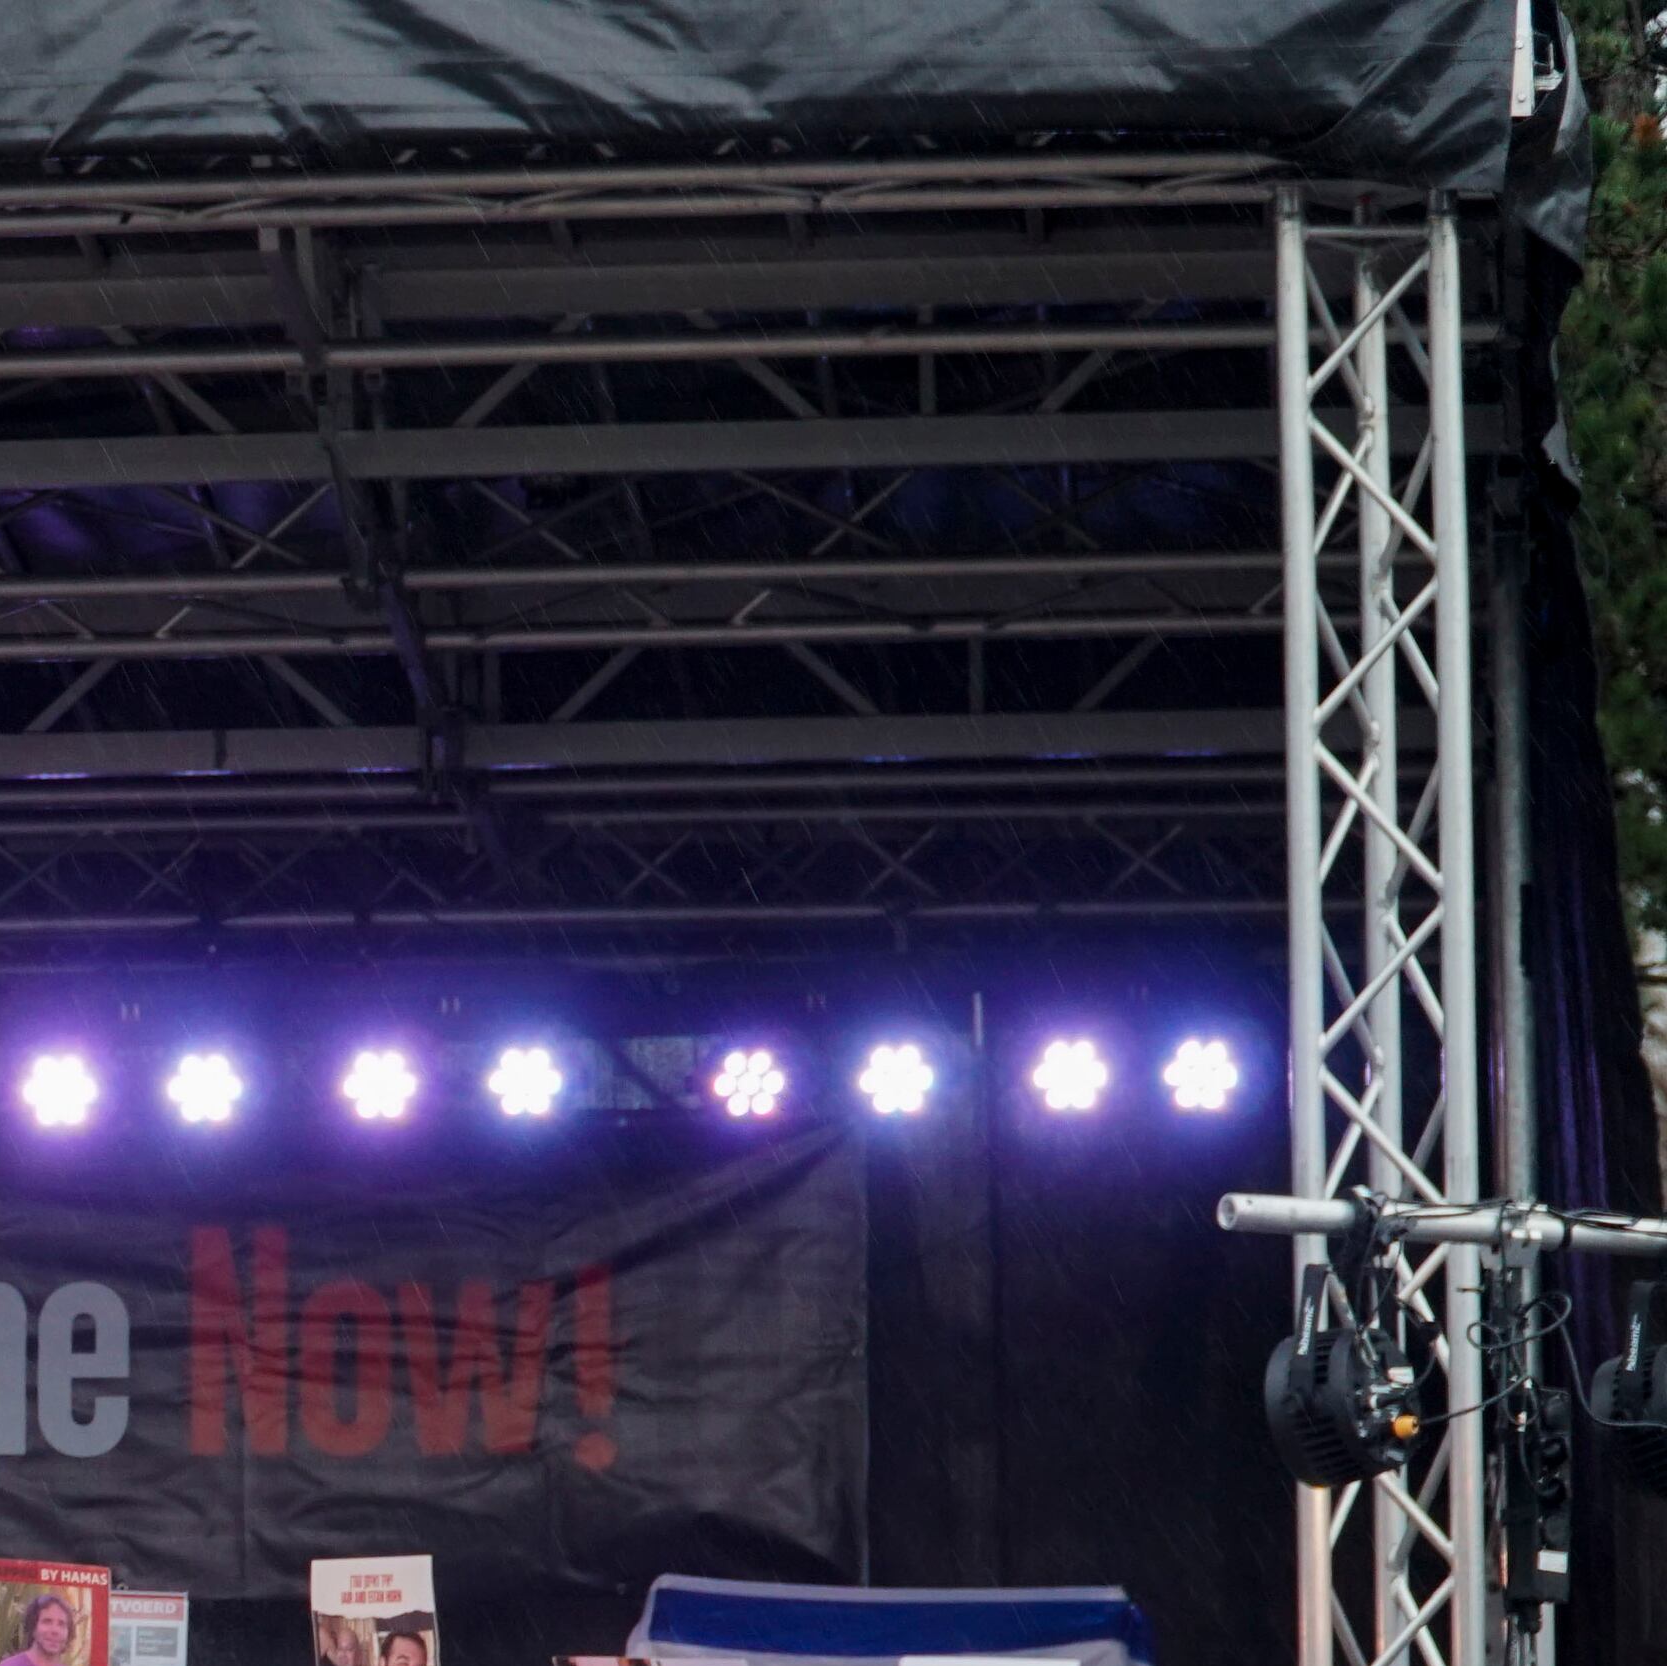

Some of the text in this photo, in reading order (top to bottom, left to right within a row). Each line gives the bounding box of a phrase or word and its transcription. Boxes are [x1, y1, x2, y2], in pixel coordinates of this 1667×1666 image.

[188, 1224, 616, 1472] Now!
[41, 1569, 108, 1586] BY HAMAS
